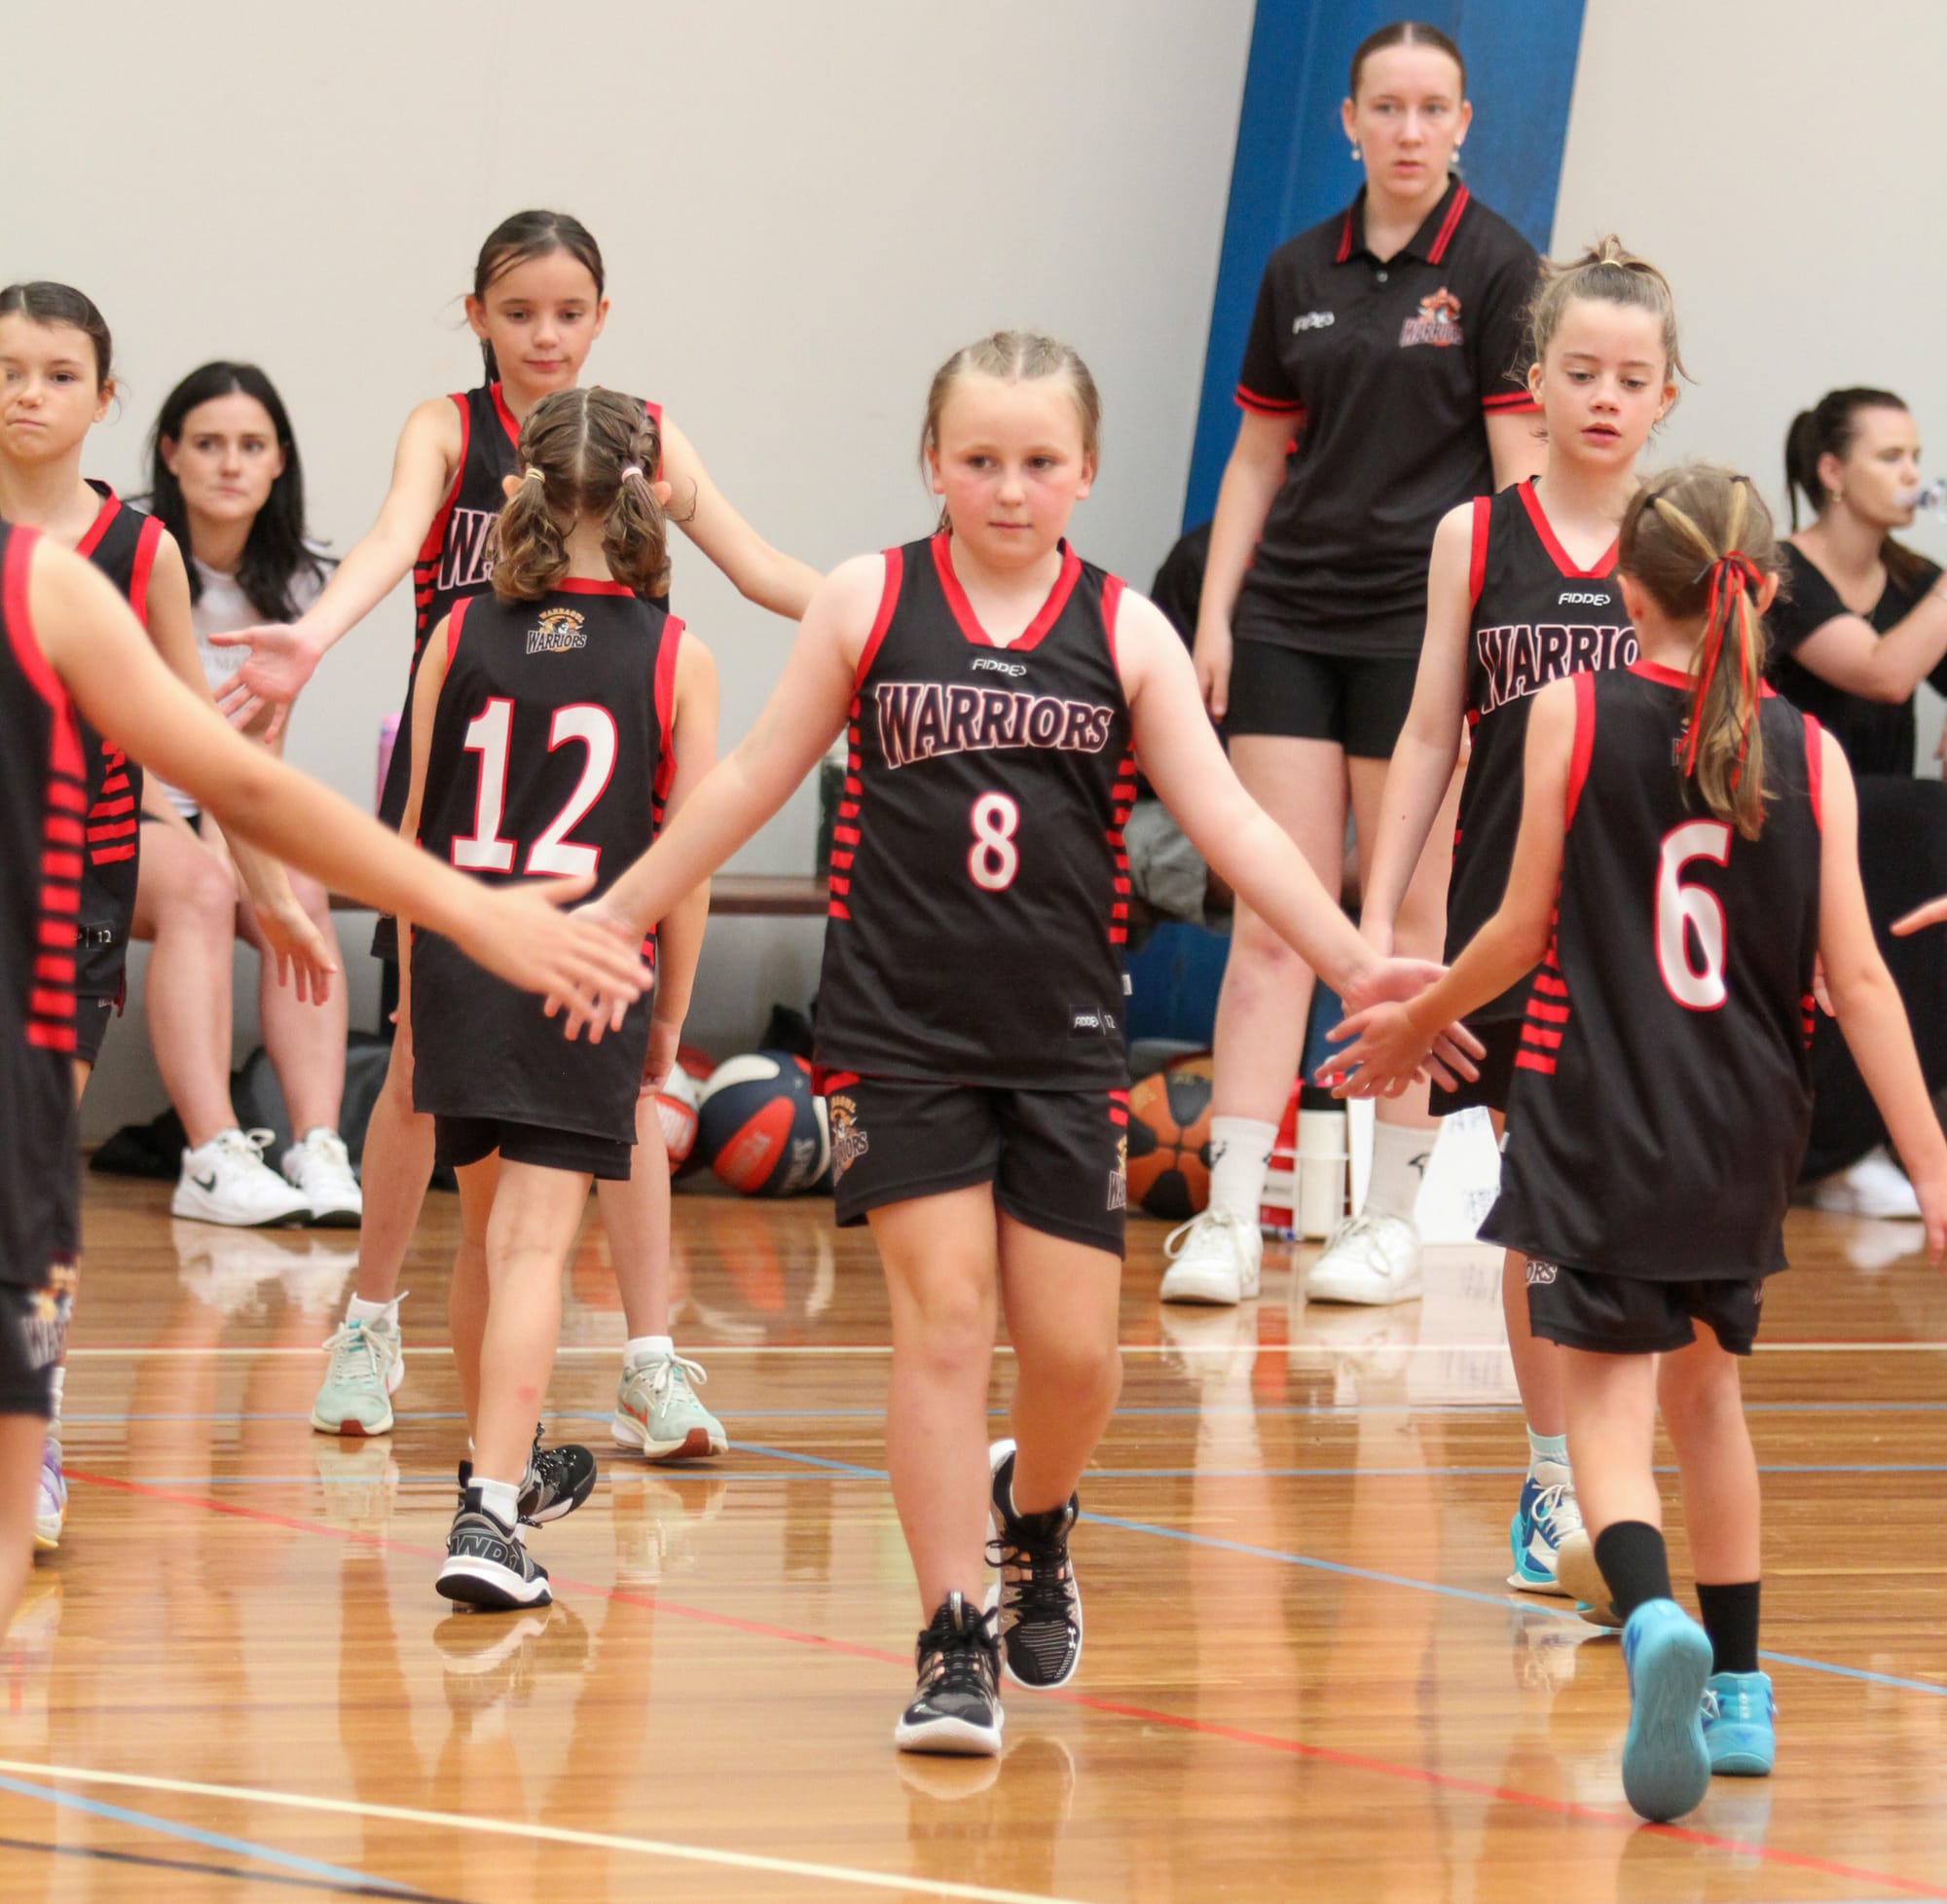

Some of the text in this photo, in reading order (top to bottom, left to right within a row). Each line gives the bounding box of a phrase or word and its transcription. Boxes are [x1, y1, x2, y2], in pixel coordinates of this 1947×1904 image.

[527, 630, 587, 654] WARRIORS
[1477, 624, 1642, 714] WARRIO
[875, 683, 1114, 769] WARRIORS
[451, 695, 619, 879] 12
[968, 790, 1019, 893] 8
[97, 929, 112, 943] 12
[1653, 818, 1733, 1012] 6
